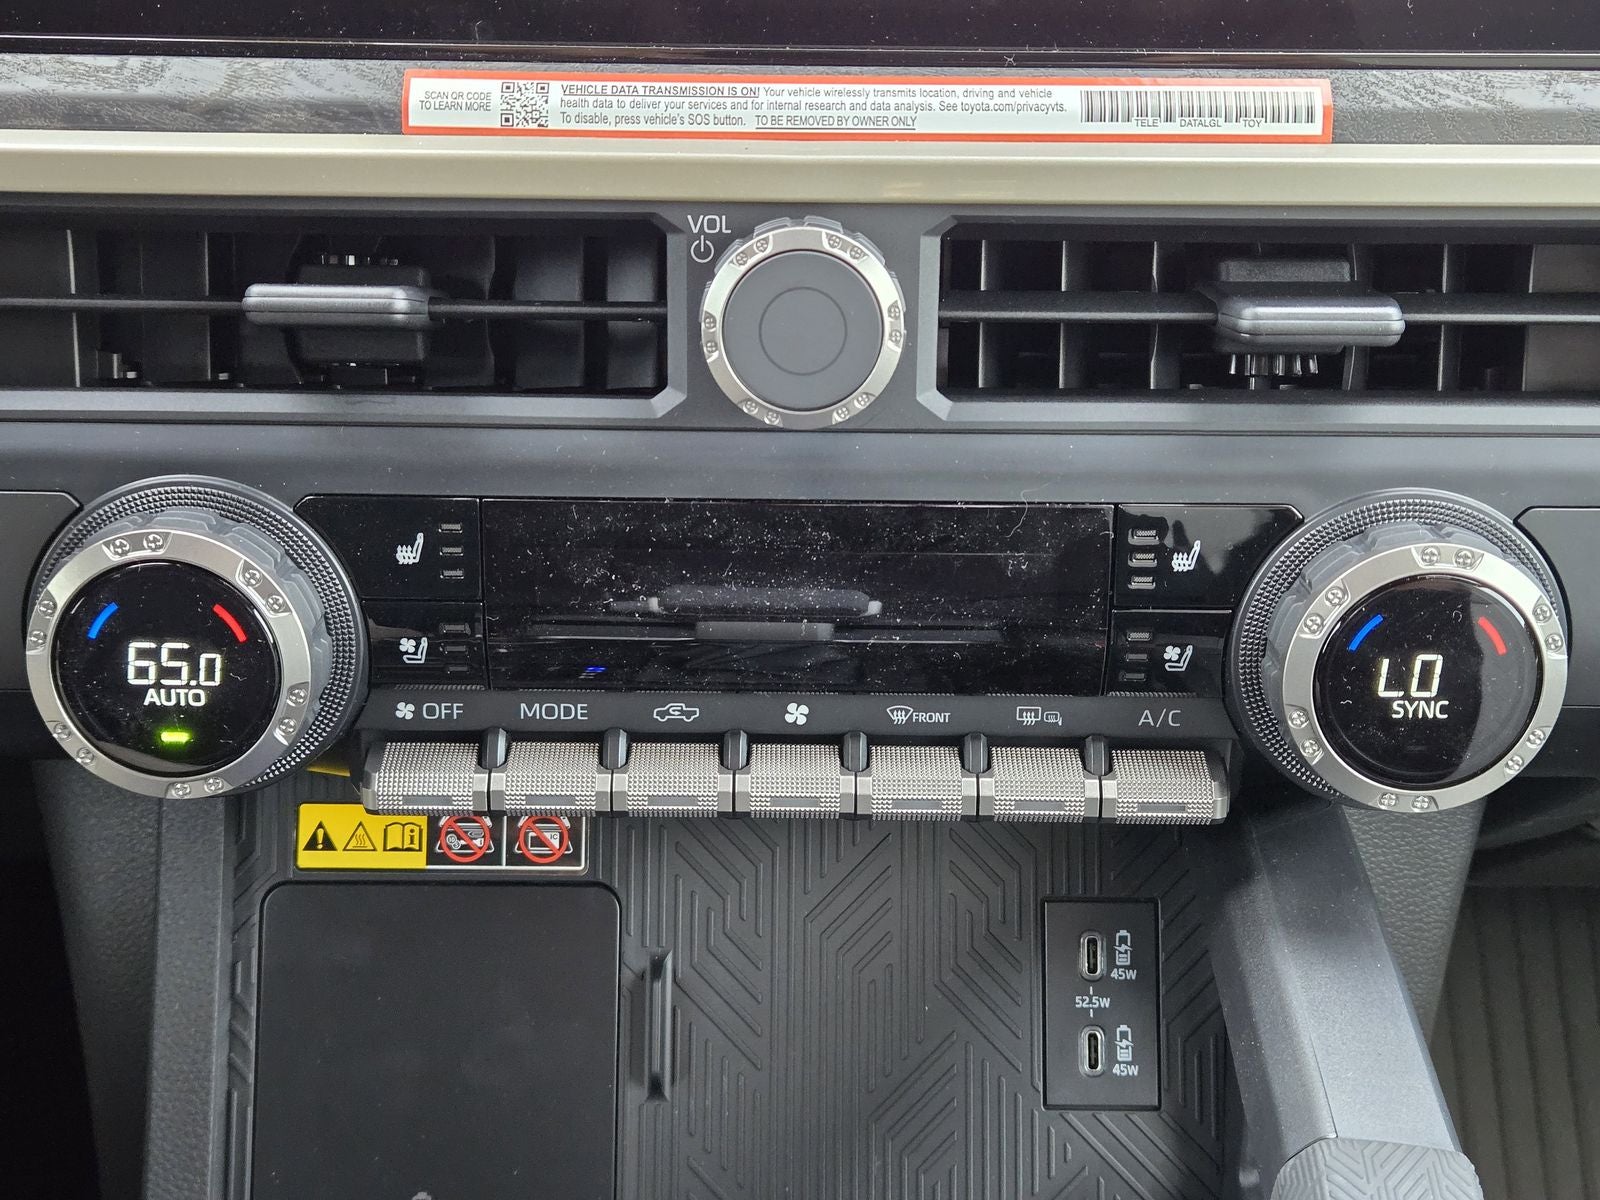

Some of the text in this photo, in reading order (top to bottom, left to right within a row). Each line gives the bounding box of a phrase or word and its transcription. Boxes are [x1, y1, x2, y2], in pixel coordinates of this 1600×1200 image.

[424, 91, 492, 101] SCAN QR CODE
[561, 84, 1052, 100] VEHICLE DATA TRANSMISSION IS ON! Your vehicle wirelessly transmits location, driving and vehicle
[419, 100, 492, 112] TO LEARN MORE
[560, 98, 1067, 114] health data to deliver your services and for internal research and data analysis. See toyota.com/privacyvts.
[560, 112, 917, 127] To disable, press vehicle's SOS button. TO BE REMOVED BY OWNER ONLY
[1134, 119, 1263, 128] TELE DATALGL TOY
[687, 215, 732, 234] VOL
[127, 641, 222, 686] 65.0
[144, 688, 206, 707] AUTO
[422, 703, 464, 720] OFF
[520, 703, 588, 720] MODE
[912, 712, 951, 723] FRONT
[1391, 700, 1449, 719] SYNC
[1138, 709, 1181, 727] A/C
[1110, 968, 1137, 980] 45W
[1075, 996, 1110, 1009] 52.5W
[1112, 1064, 1139, 1077] 45W
